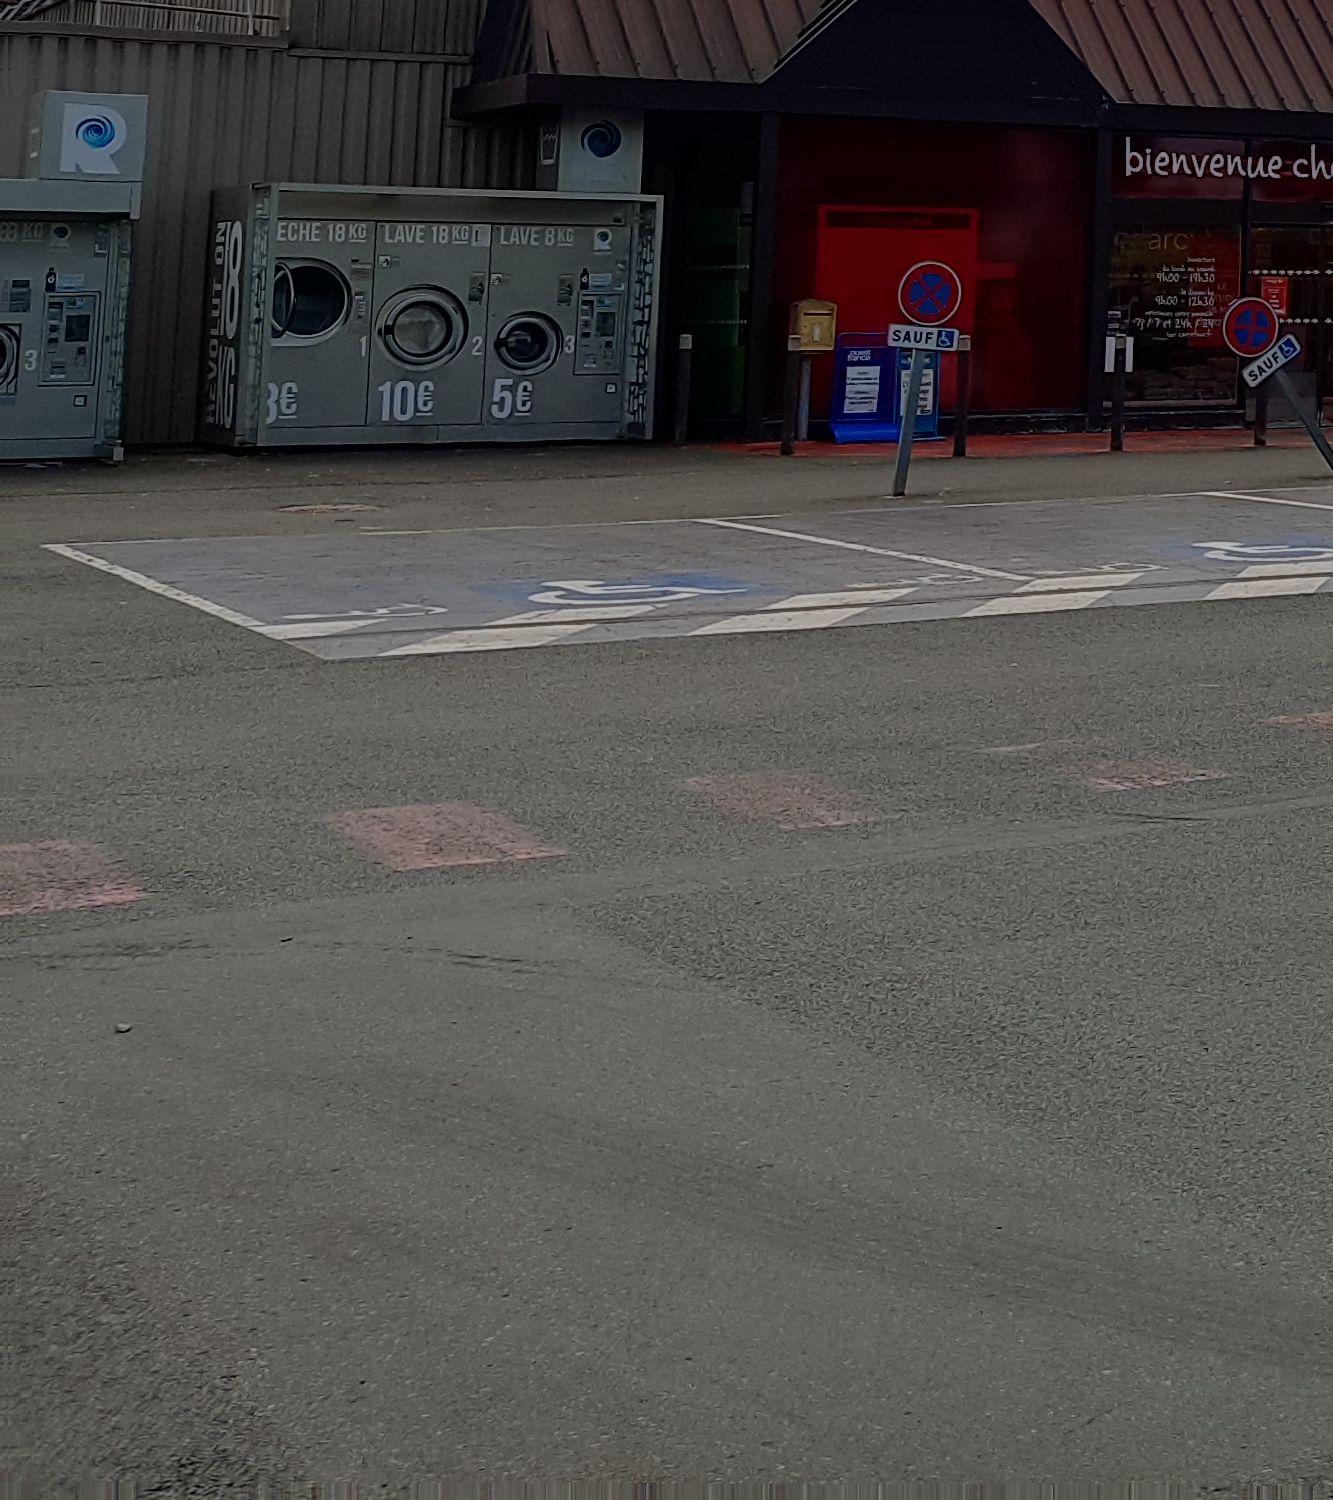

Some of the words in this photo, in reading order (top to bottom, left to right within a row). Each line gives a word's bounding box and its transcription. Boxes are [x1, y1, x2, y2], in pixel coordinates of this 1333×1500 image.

[1125, 136, 1282, 179] bienvenue
[276, 223, 322, 242] ECHE
[328, 223, 346, 242] 18
[350, 223, 367, 240] KG
[384, 225, 426, 244] LAVE
[431, 225, 448, 244] 18
[452, 225, 469, 241] KG
[500, 228, 540, 246] LAVE
[545, 228, 556, 246] 8
[558, 228, 575, 243] KG
[1156, 272, 1180, 283] 9h00
[1189, 273, 1215, 283] 19h30
[206, 222, 226, 423] REVOLUTON
[360, 337, 367, 357] 1
[472, 336, 483, 356] 2
[565, 335, 575, 354] 3
[892, 329, 934, 345] SAUF
[24, 349, 37, 371] 3
[1248, 352, 1280, 382] SAUF
[378, 381, 434, 422] 10€
[490, 378, 533, 419] 5€
